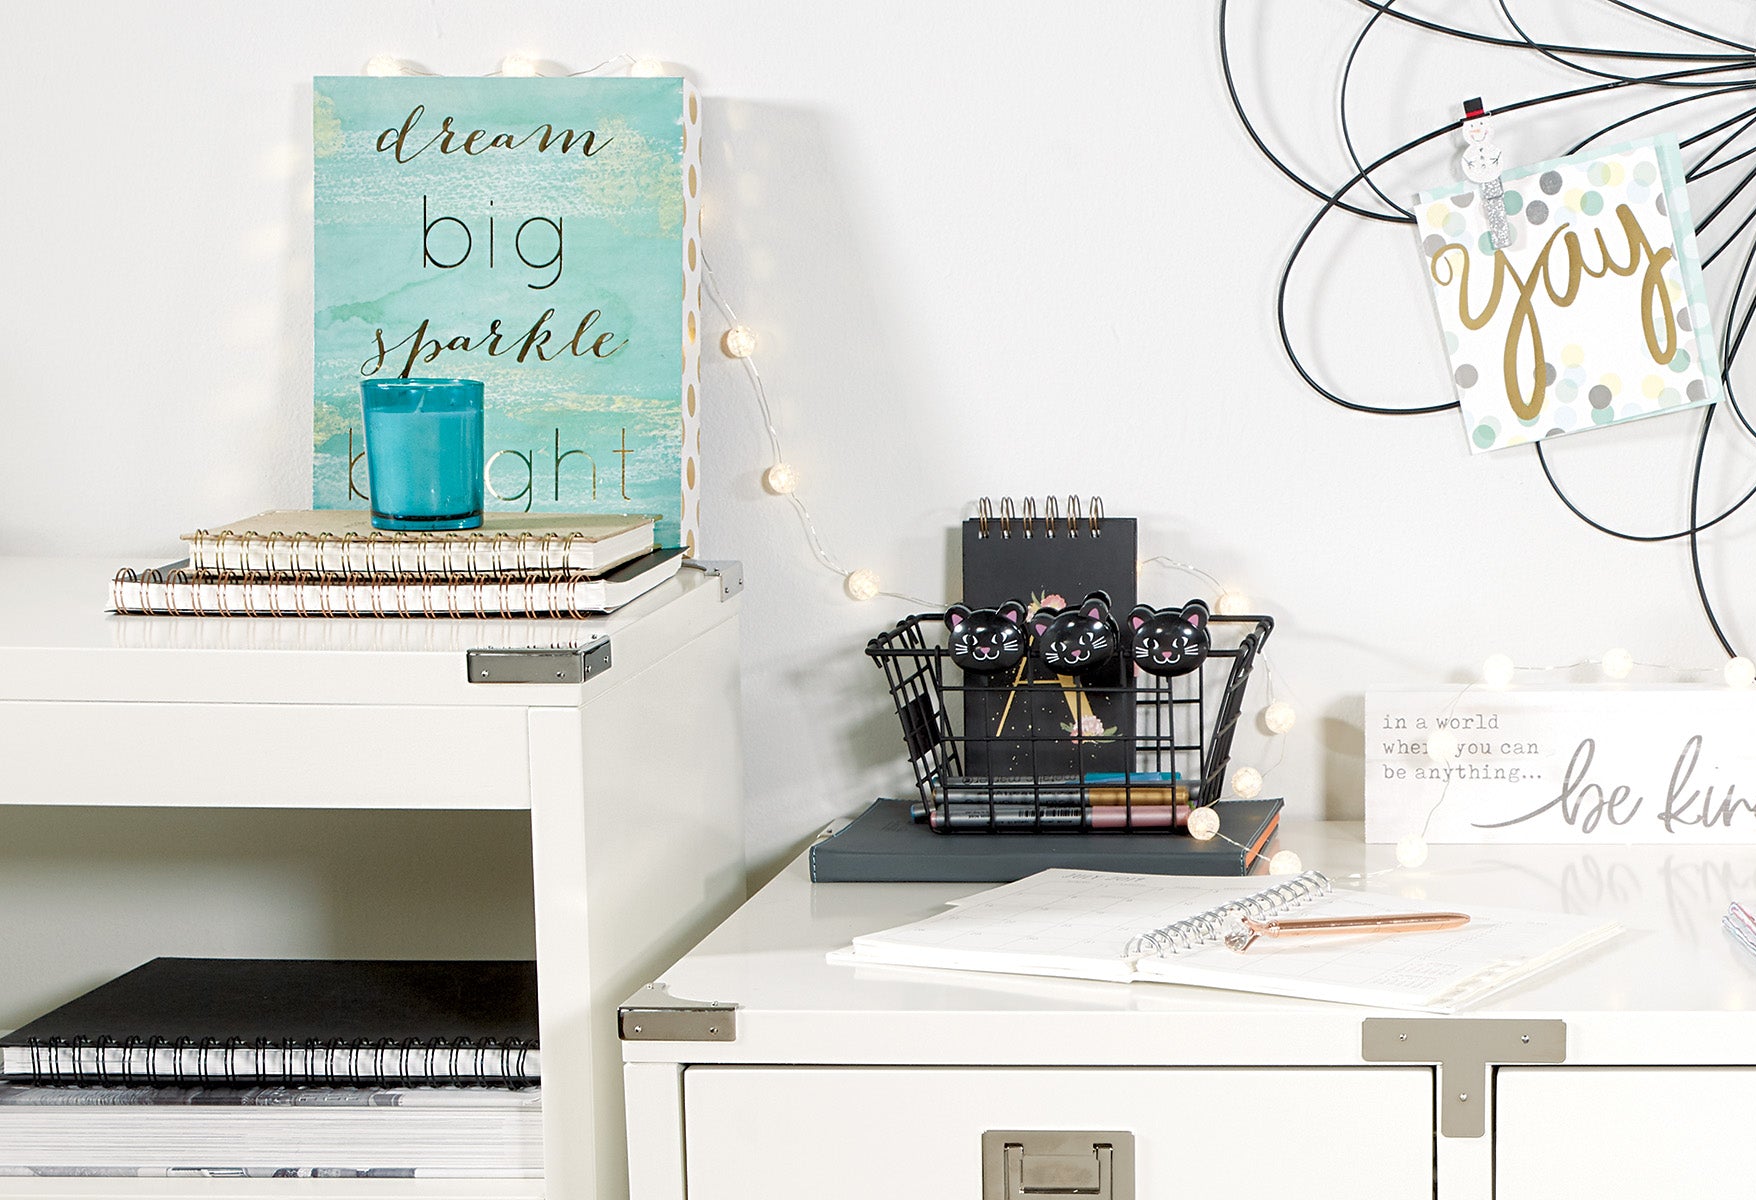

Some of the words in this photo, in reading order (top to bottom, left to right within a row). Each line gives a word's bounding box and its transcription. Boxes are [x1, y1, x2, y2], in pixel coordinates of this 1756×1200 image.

[375, 104, 615, 164] dream
[422, 194, 564, 290] big
[360, 308, 630, 379] sparkle
[1430, 203, 1677, 421] yay
[349, 427, 634, 513] bght
[1382, 714, 1407, 729] in
[1415, 716, 1428, 729] a
[1436, 713, 1499, 729] world
[1382, 739, 1428, 754] whe
[1454, 742, 1492, 758] you
[1500, 742, 1539, 754] can
[1382, 764, 1407, 779] be
[1414, 764, 1542, 783] anything...
[1471, 737, 1644, 834] be
